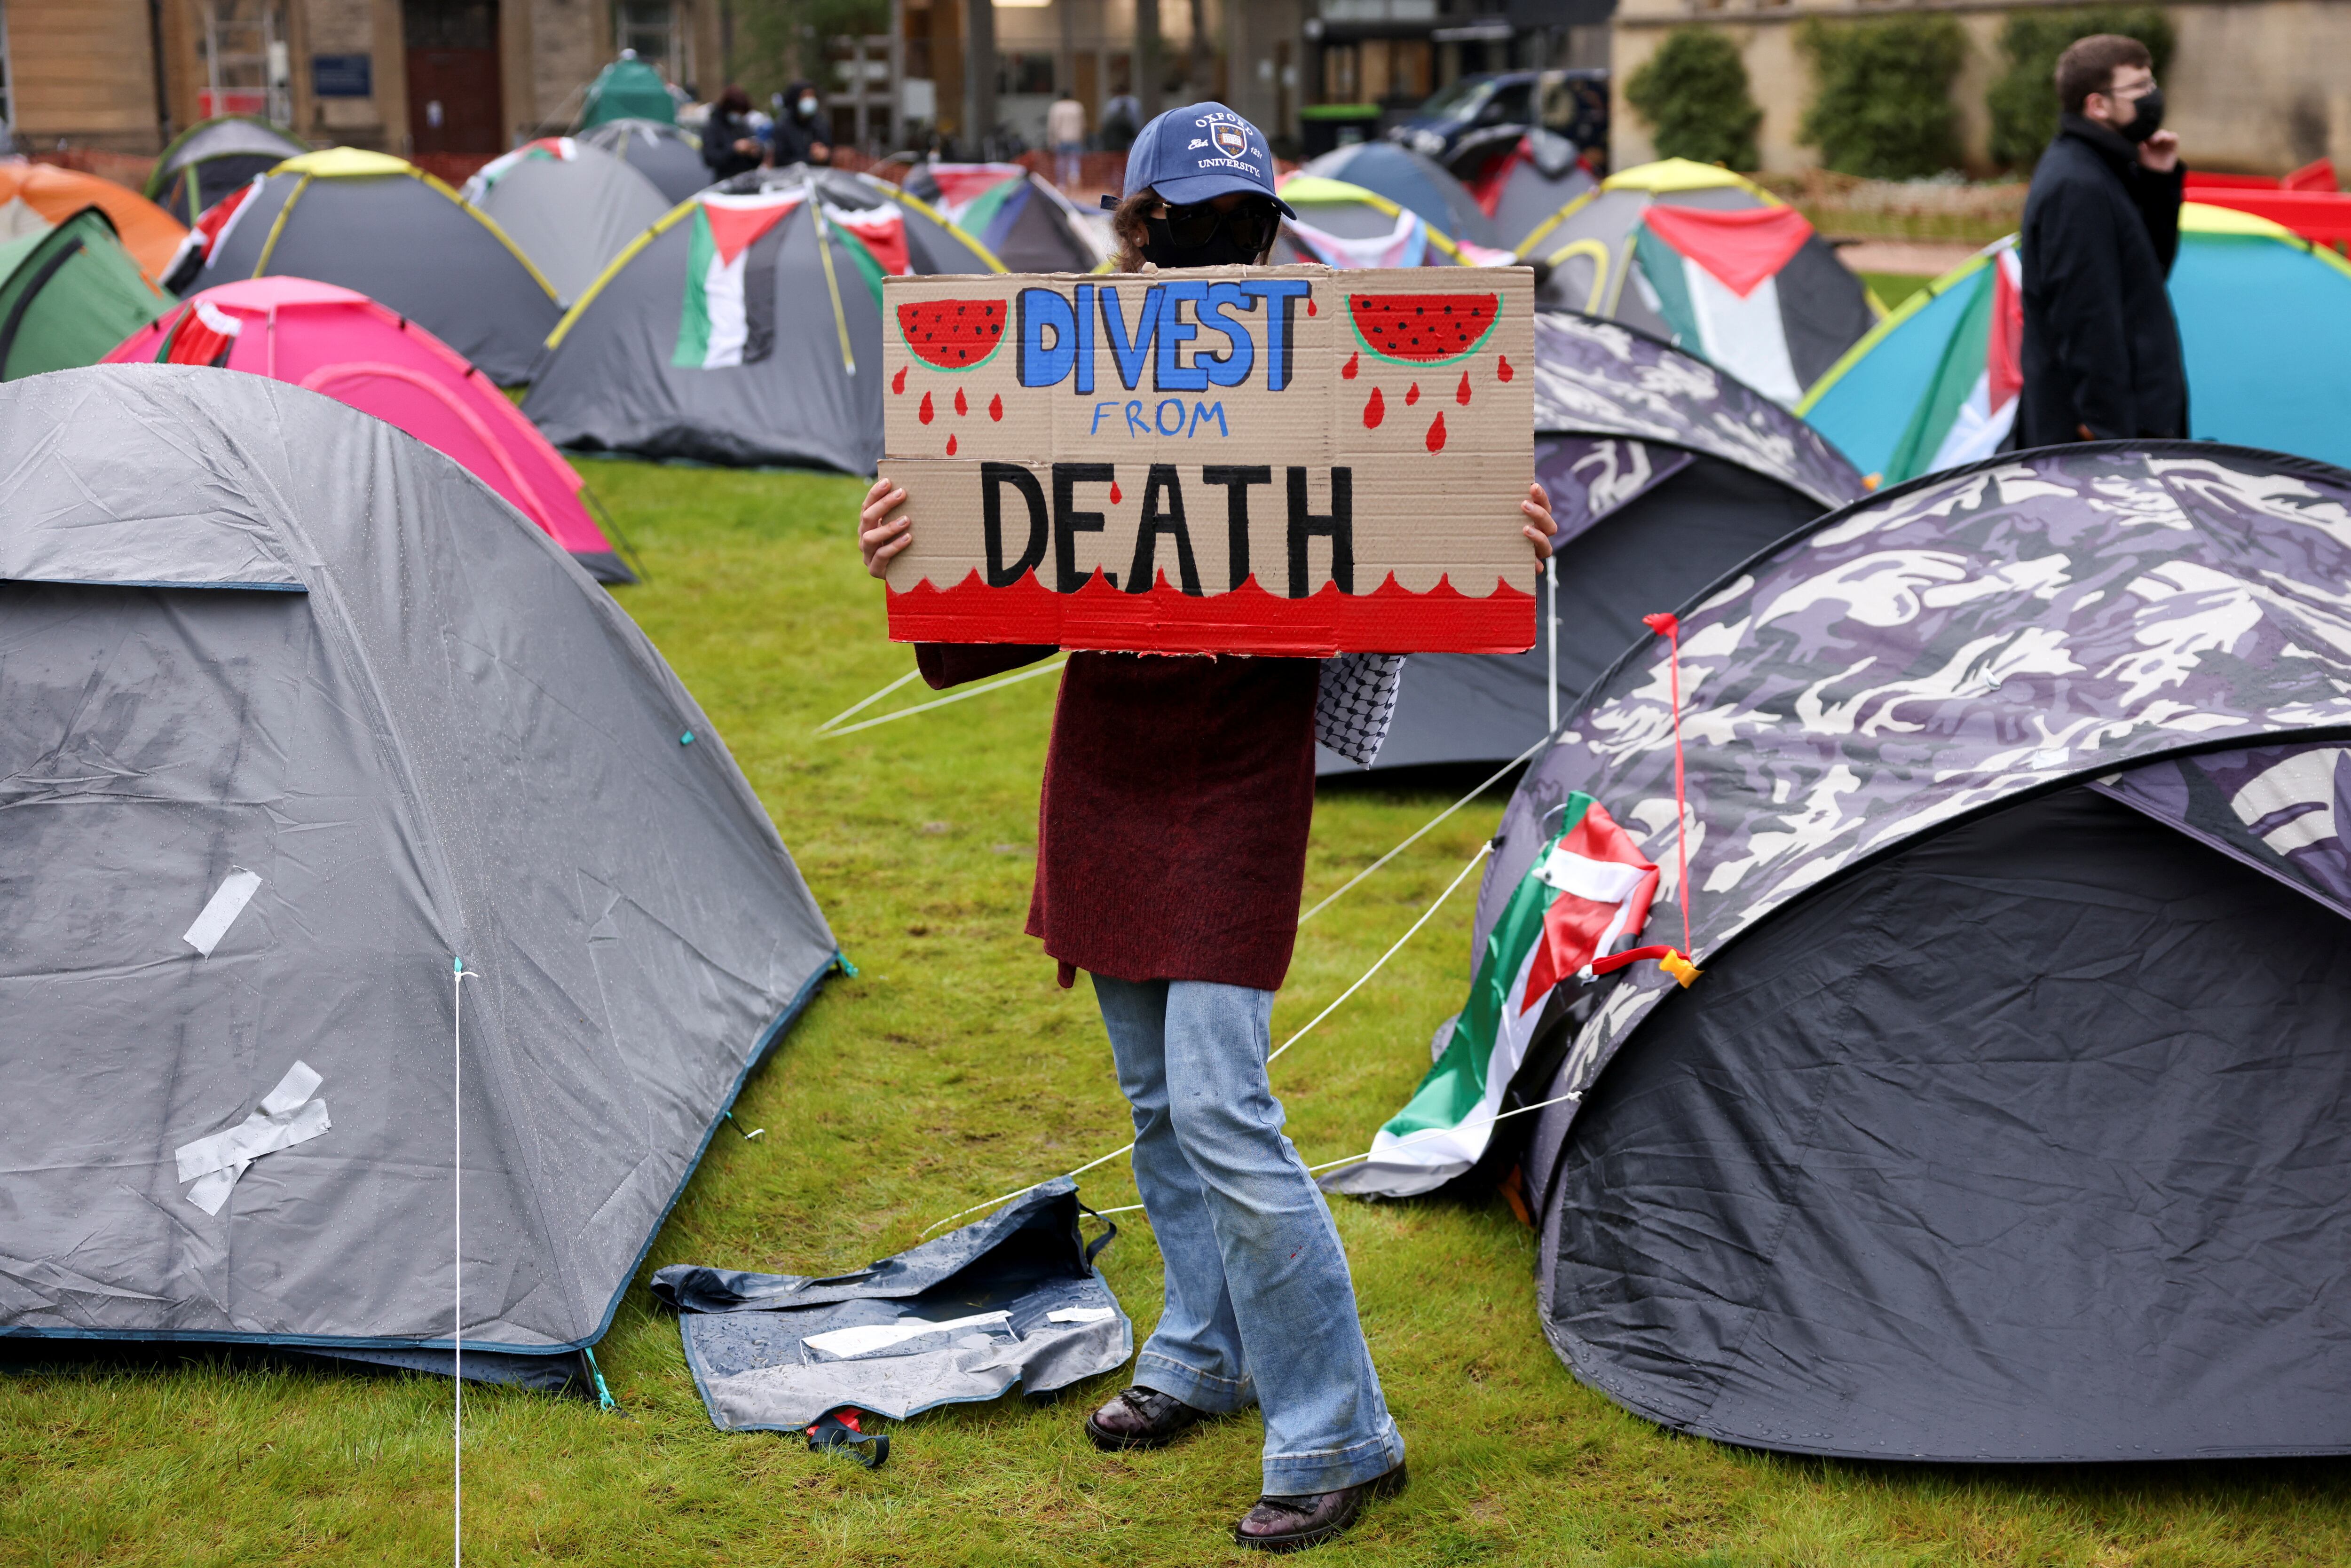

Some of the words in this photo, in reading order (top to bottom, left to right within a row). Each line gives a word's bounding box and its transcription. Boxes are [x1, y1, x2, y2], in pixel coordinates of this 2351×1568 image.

[1196, 112, 1253, 135] OXFORD
[1188, 139, 1208, 150] Est.
[1251, 147, 1262, 159] 1231
[1198, 158, 1260, 177] UNIVERSITY
[1016, 280, 1312, 395] DIVEST
[1090, 398, 1229, 438] FROM
[981, 462, 1353, 599] DEATH
